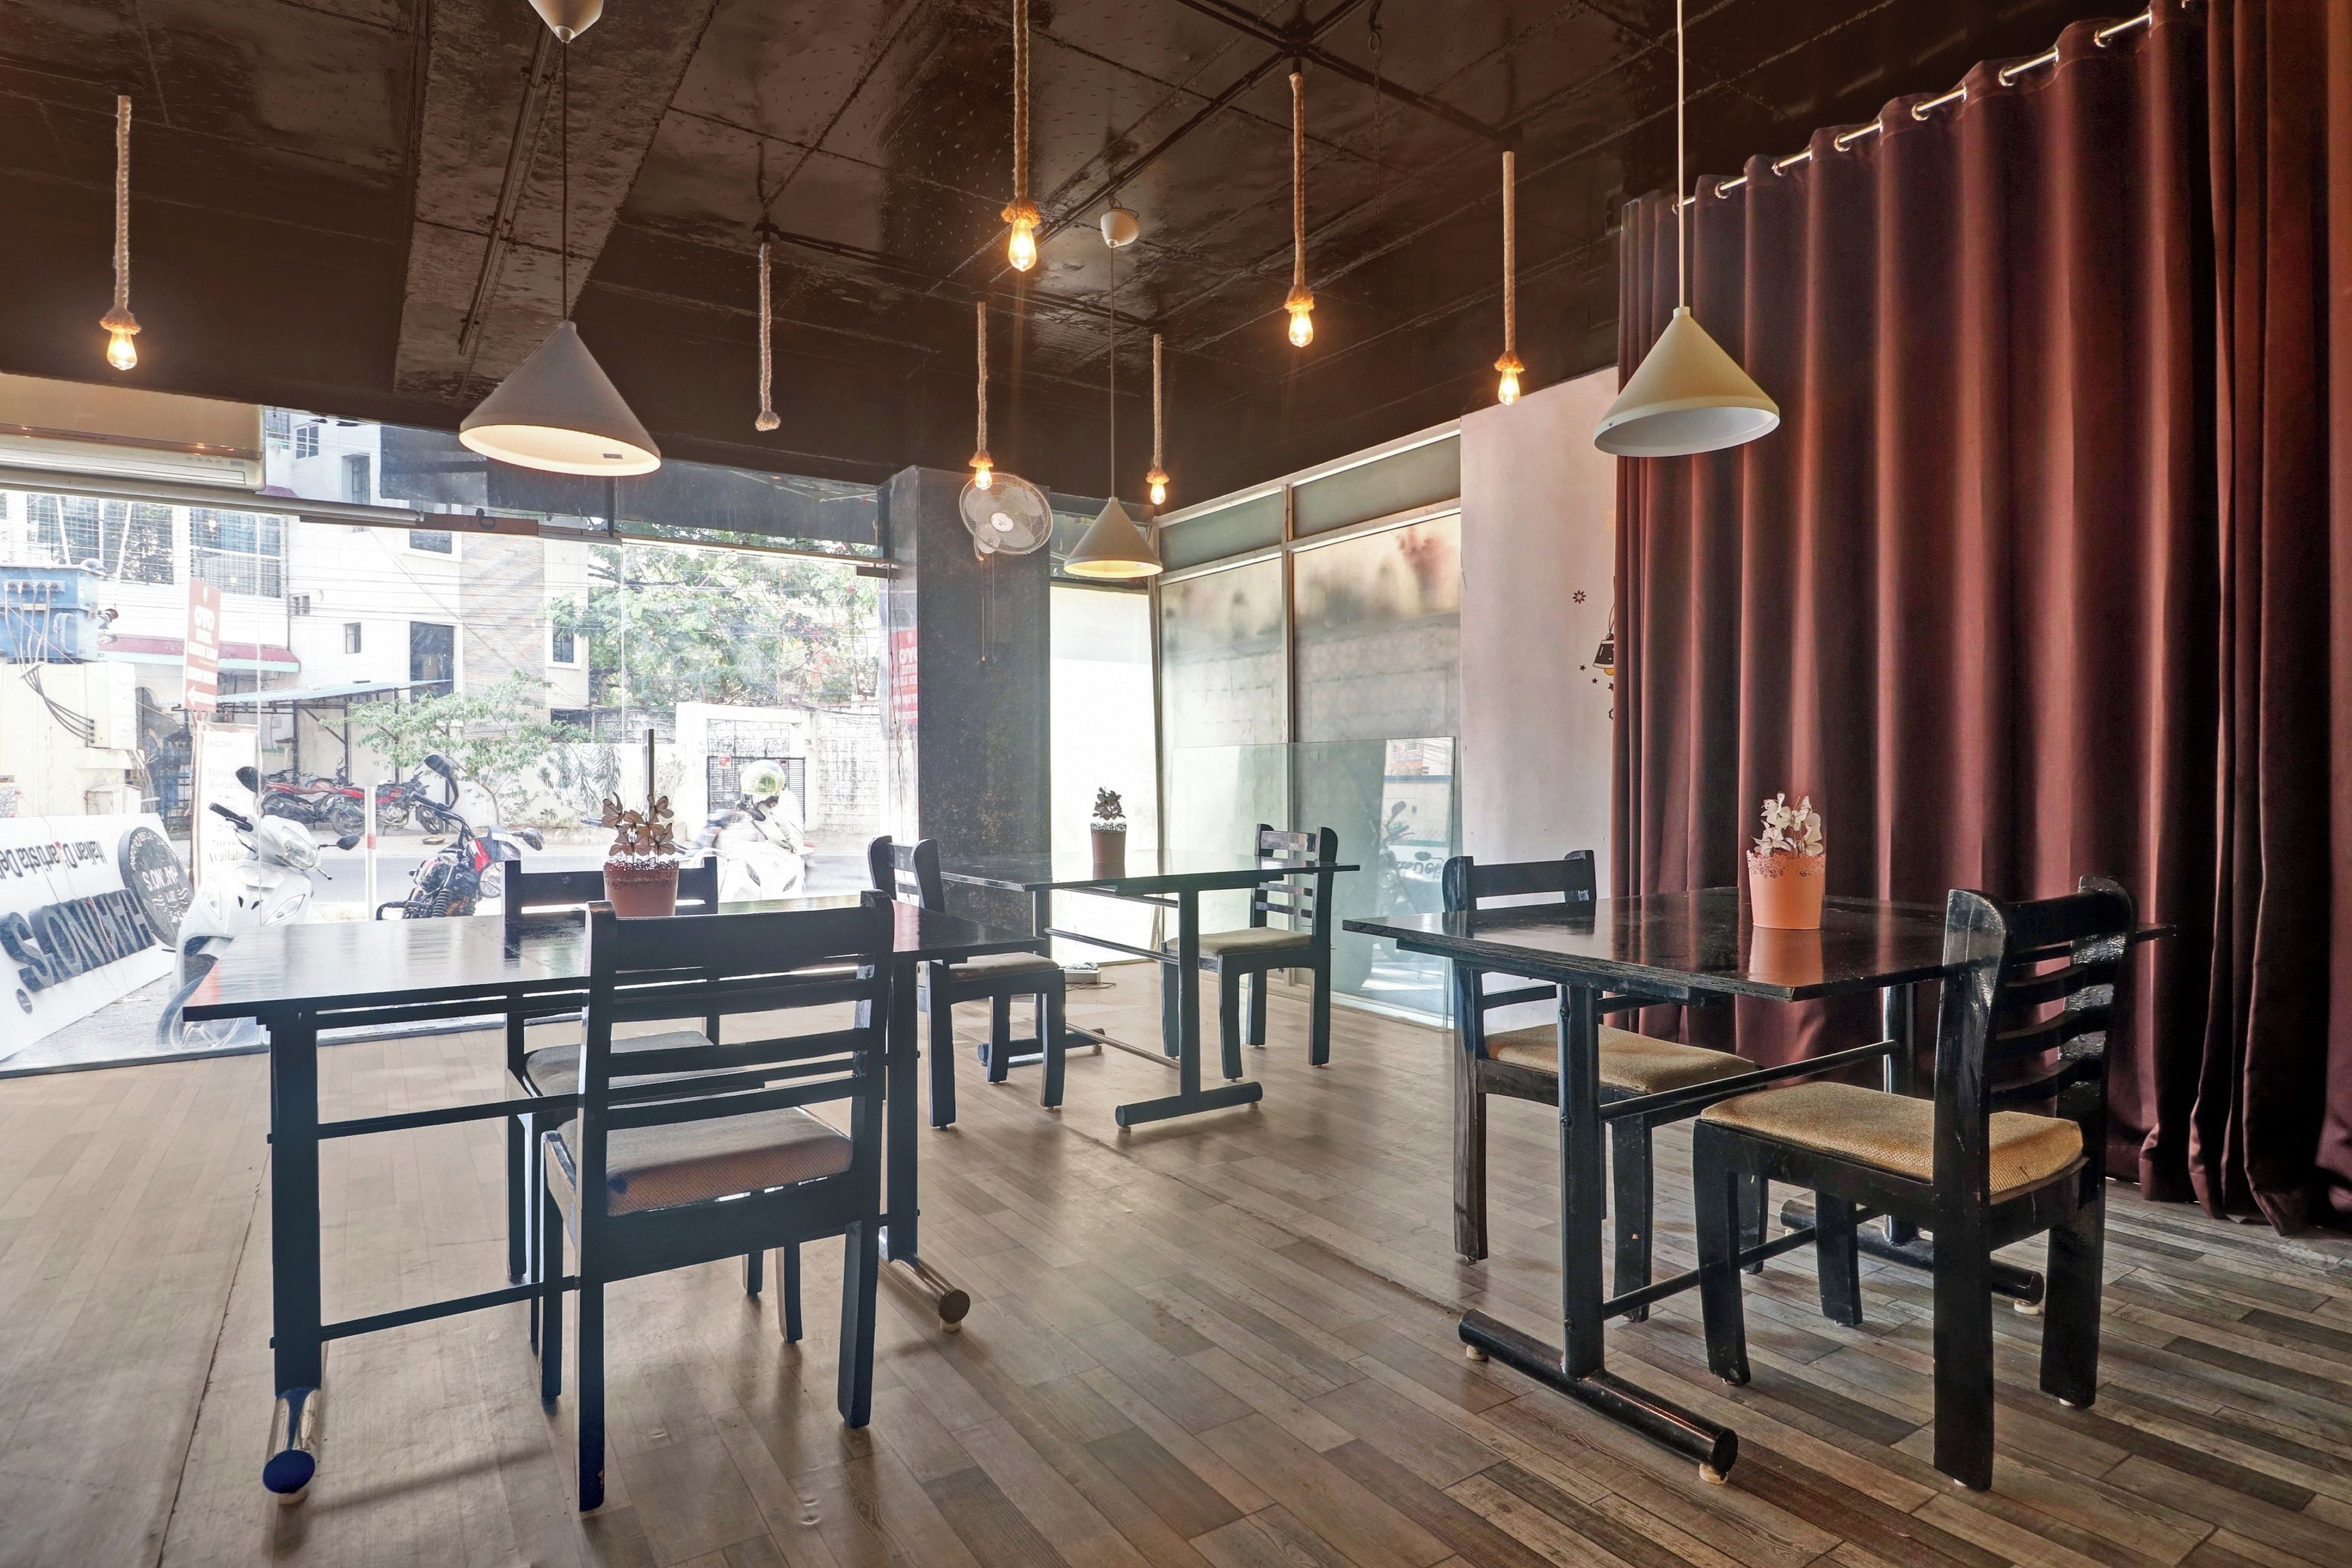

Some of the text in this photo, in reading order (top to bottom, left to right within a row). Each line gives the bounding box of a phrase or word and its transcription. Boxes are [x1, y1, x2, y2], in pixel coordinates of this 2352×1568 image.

[195, 604, 214, 632] OYO
[210, 779, 242, 789] Restaura
[75, 840, 108, 865] Italian
